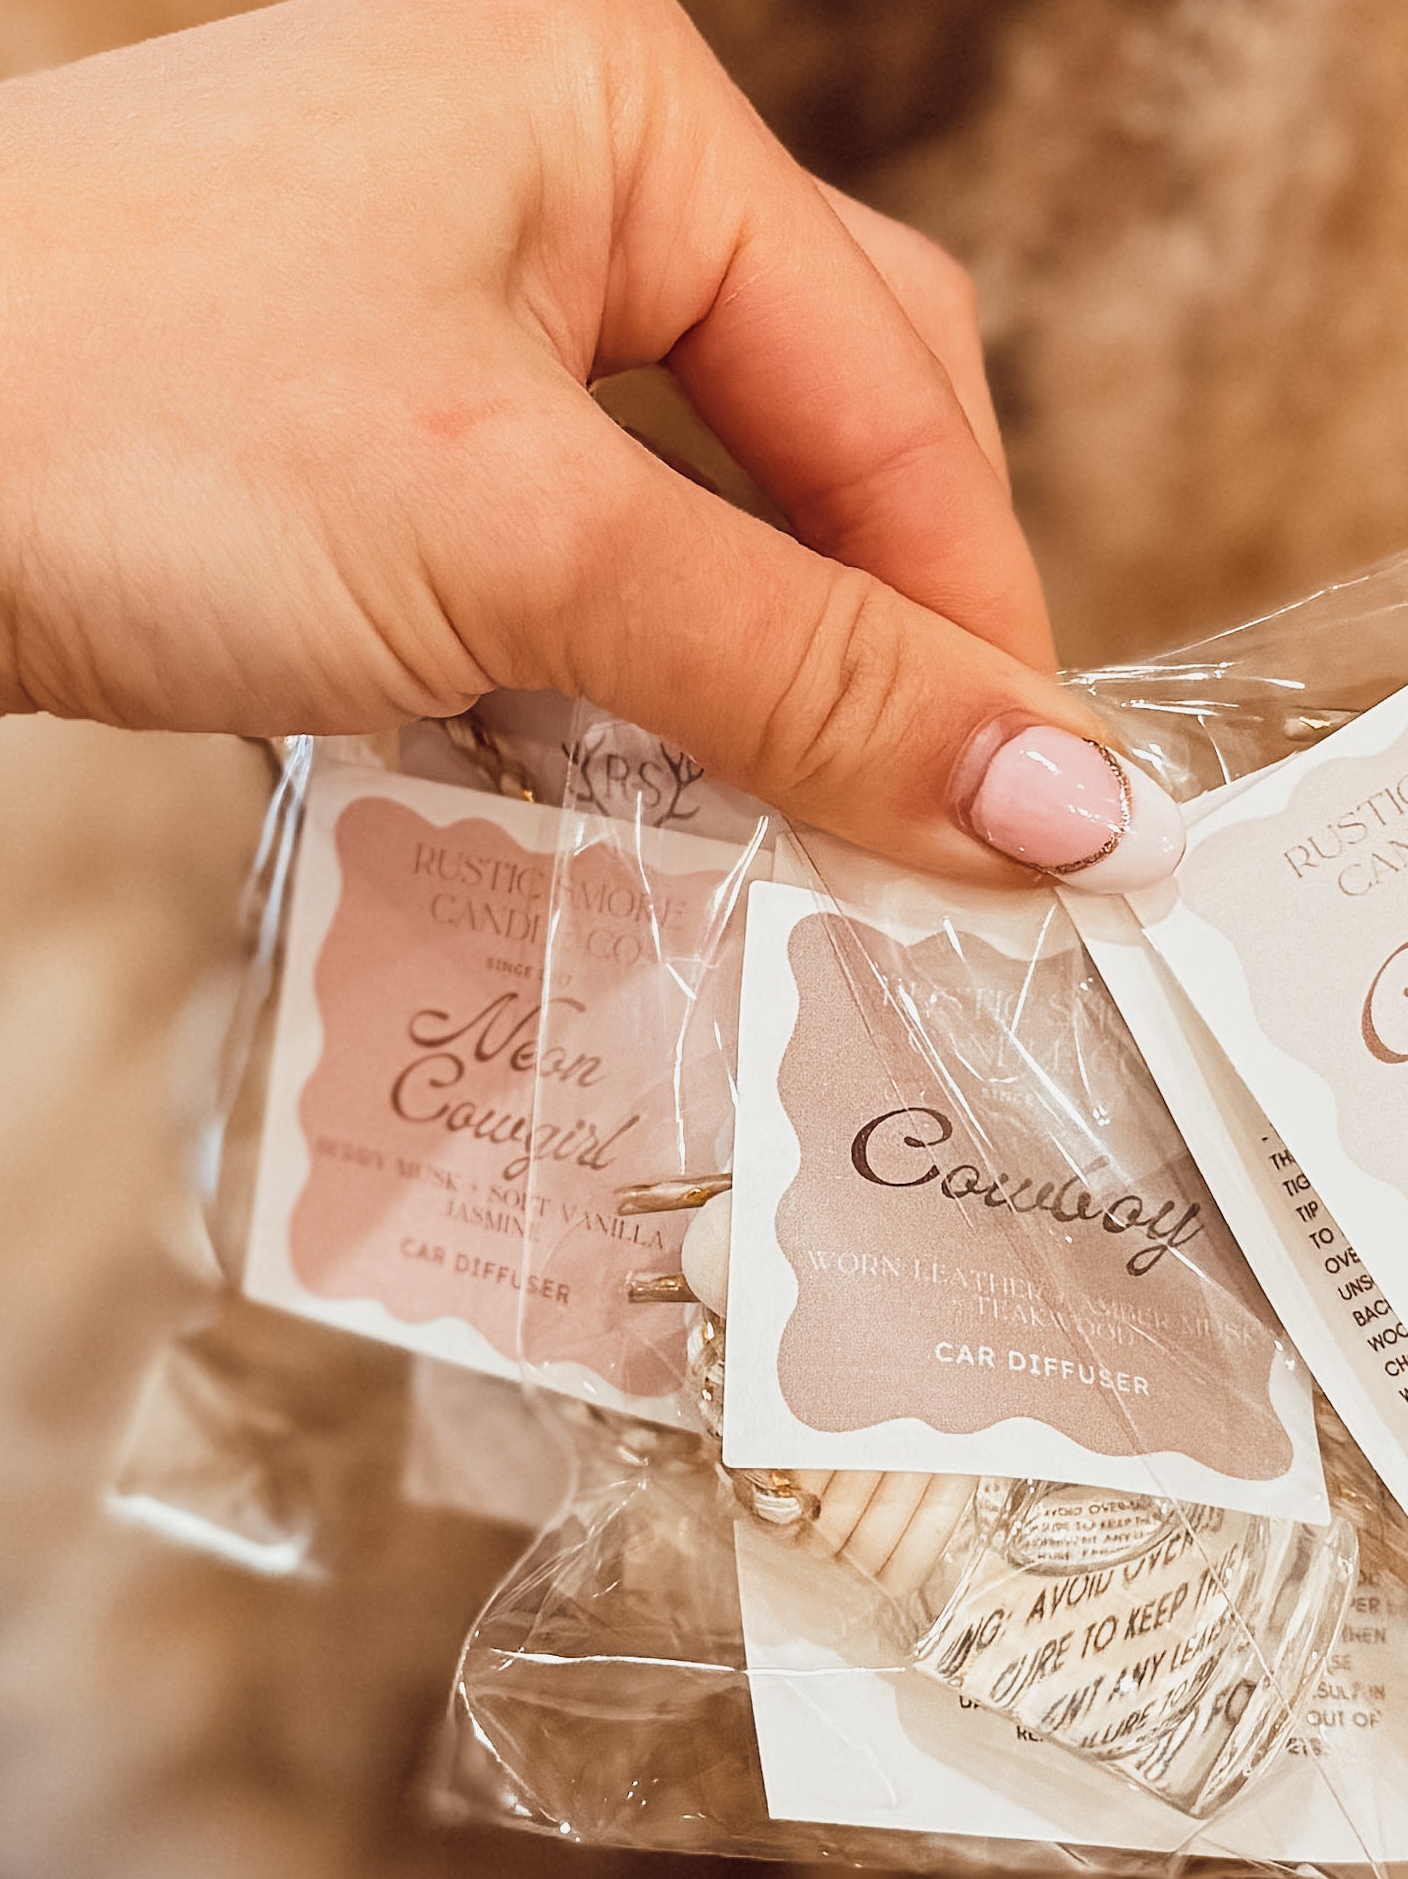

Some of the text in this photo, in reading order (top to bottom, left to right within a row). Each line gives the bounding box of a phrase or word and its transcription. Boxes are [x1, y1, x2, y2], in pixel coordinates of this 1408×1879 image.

[414, 842, 545, 901] RUSTIC
[409, 992, 605, 1088] Neon
[391, 1052, 641, 1181] Cowgirl
[850, 1106, 1205, 1277] Cowboy
[1295, 1200, 1319, 1223] TIP
[561, 1201, 664, 1250] VANILLA
[1308, 1227, 1335, 1250] TO
[400, 1235, 571, 1304] CAR DIFFUSER
[807, 1249, 901, 1278] WORN
[913, 1258, 1043, 1301] LEATHER
[934, 1341, 1150, 1397] CAR DIFFUSER
